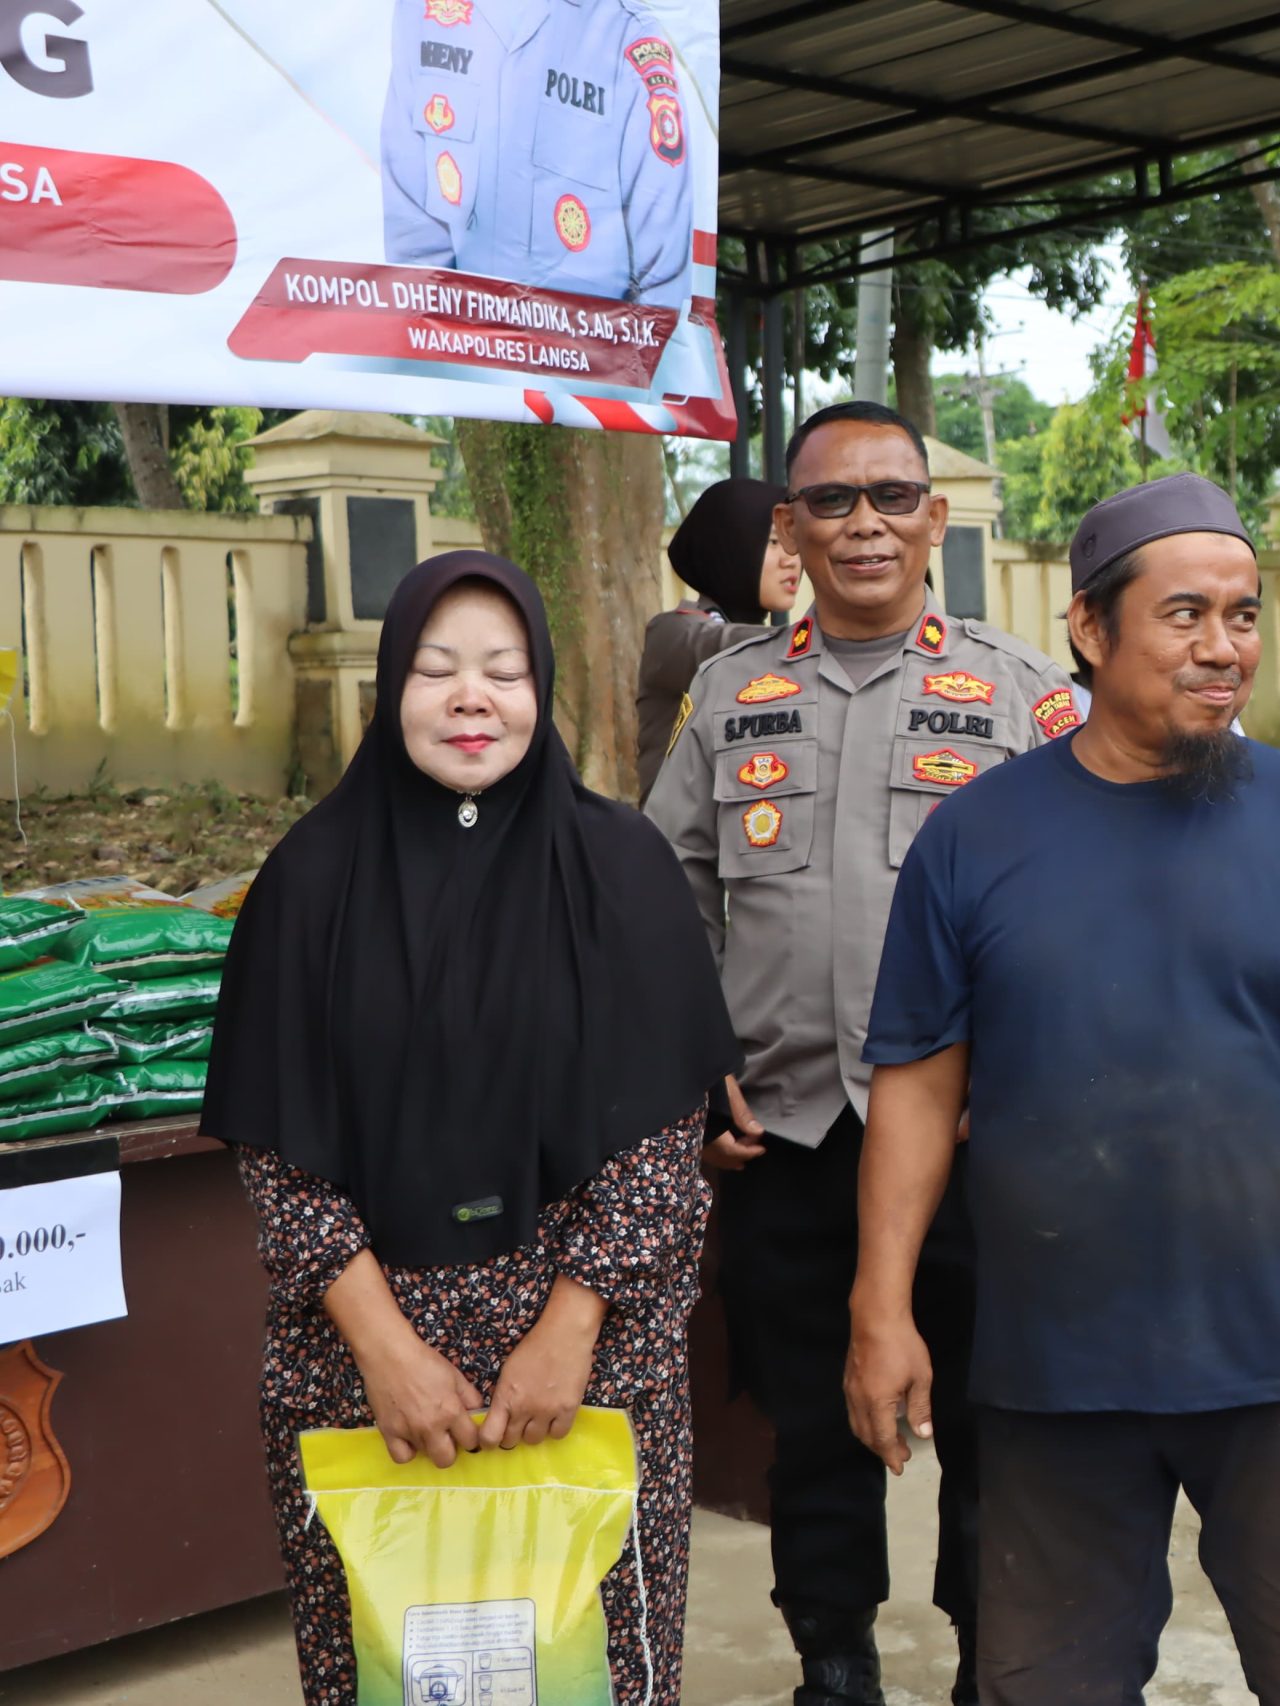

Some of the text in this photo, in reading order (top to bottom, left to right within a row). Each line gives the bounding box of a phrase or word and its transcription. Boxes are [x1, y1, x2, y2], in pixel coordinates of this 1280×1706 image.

[545, 69, 606, 116] POLRI
[0, 162, 64, 207] SA
[285, 273, 660, 347] KOMPOL DHENY FIRMANDIKA, S.Ab, S.I.K.
[408, 327, 591, 372] WAKAPOLRES LANGSA
[725, 709, 802, 742] S.PURBA
[908, 709, 994, 739] POLRI
[0, 1271, 27, 1294] ak
